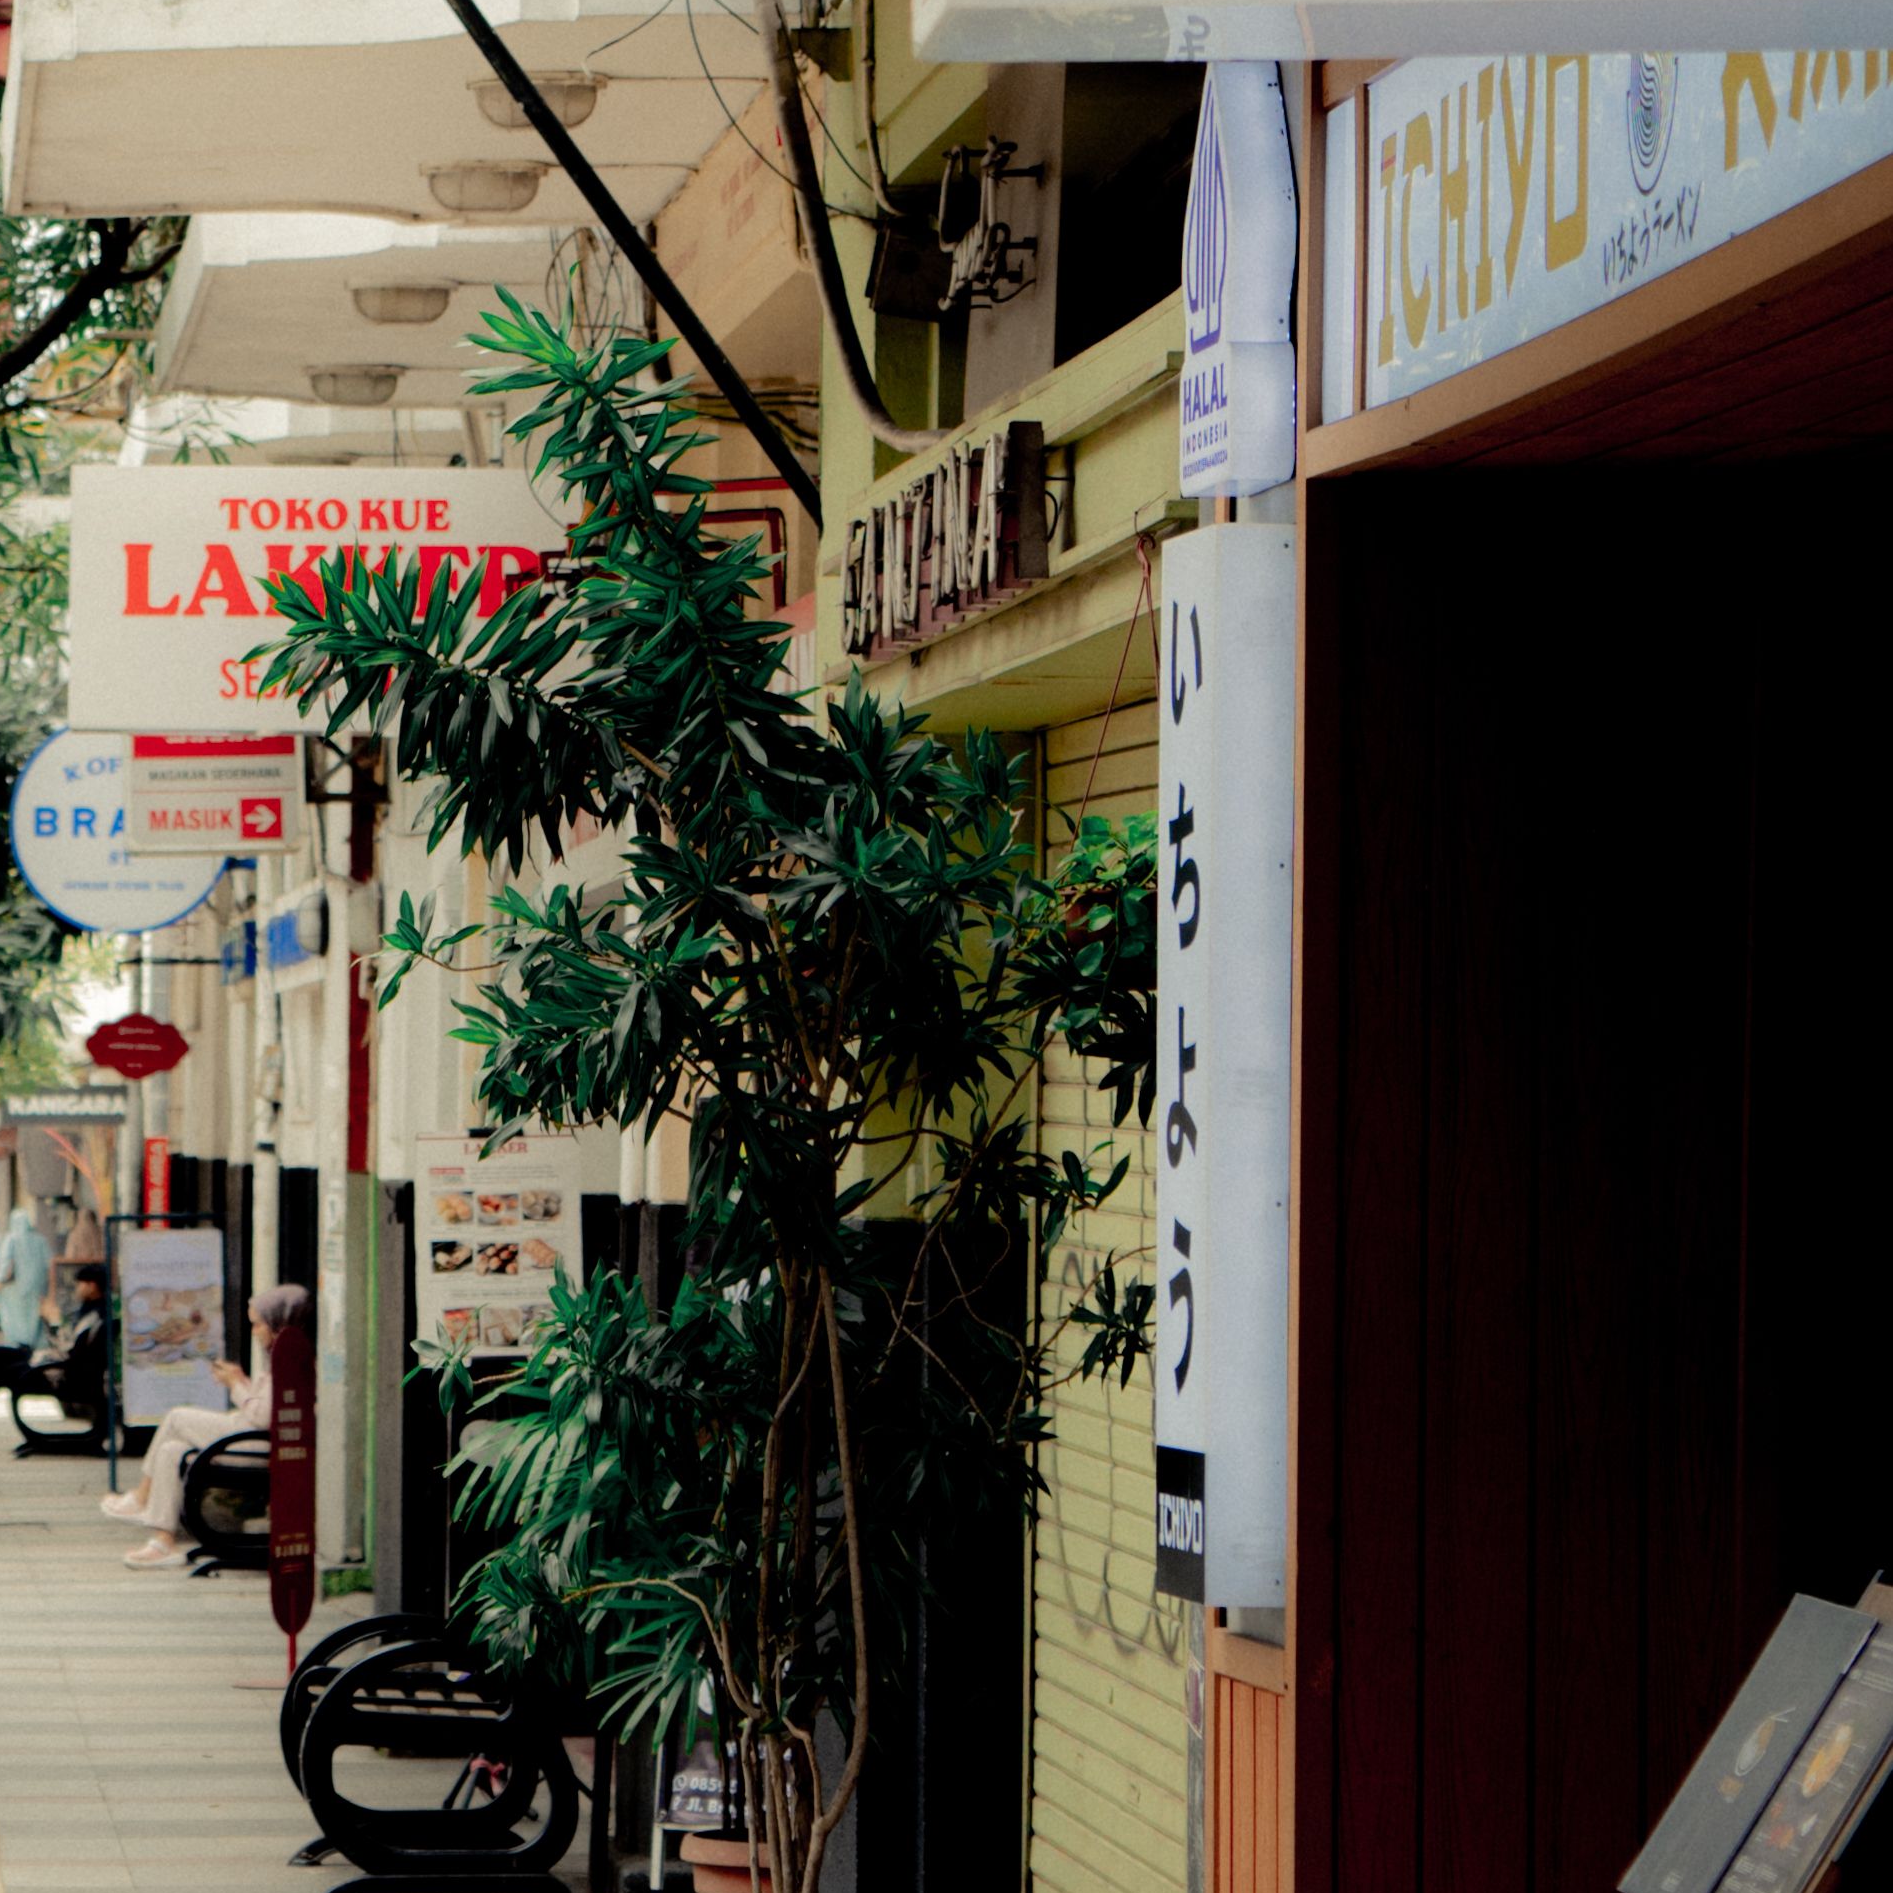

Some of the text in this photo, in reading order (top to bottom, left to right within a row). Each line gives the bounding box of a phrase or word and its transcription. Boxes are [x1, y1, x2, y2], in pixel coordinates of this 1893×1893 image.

[1377, 55, 1591, 368] ICHIYO
[1183, 362, 1228, 426] HALAL
[1182, 420, 1228, 458] INDONESIA
[220, 497, 453, 534] TOKO KUE
[148, 808, 235, 833] MASUK
[1167, 600, 1204, 1395] いちよう
[1158, 1491, 1204, 1556] ICHIYO
